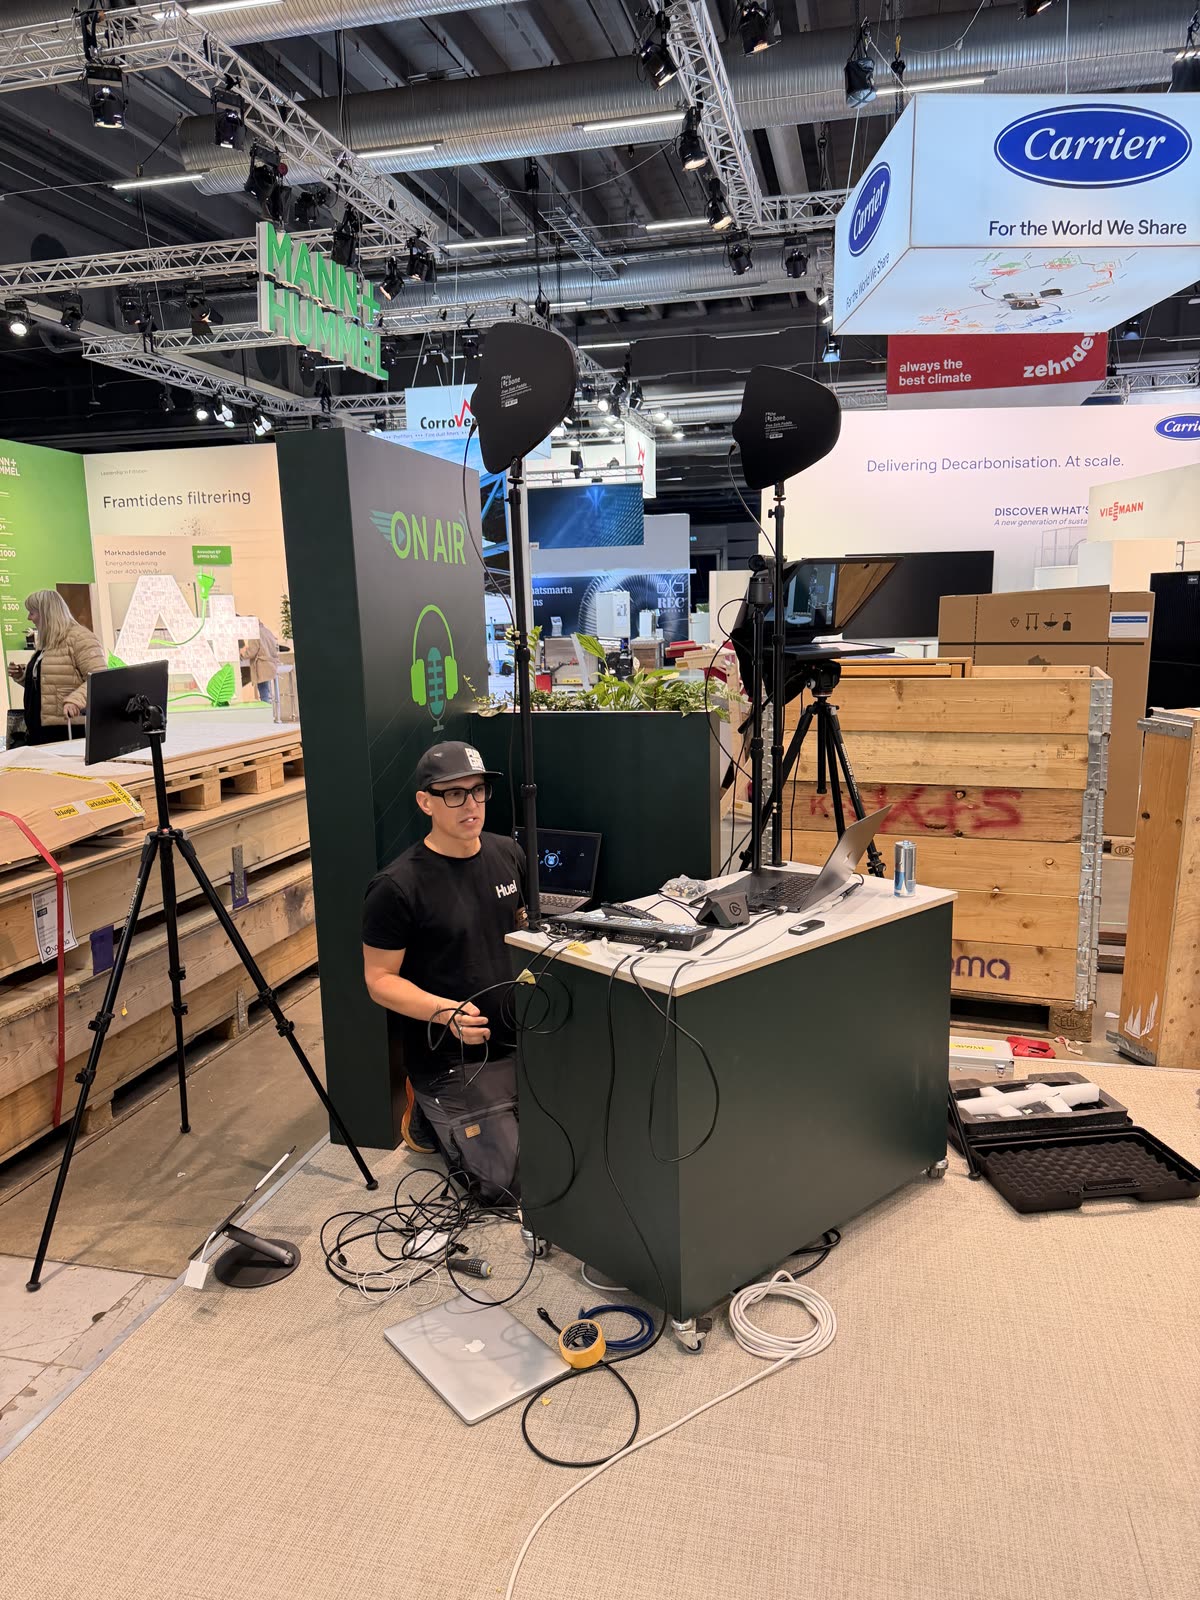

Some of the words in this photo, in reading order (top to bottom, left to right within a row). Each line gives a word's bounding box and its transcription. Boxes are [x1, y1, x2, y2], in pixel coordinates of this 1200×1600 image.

[1024, 127, 1167, 161] Carrier
[853, 181, 886, 241] Carrier
[989, 221, 1016, 236] For
[1019, 220, 1047, 236] the
[1052, 220, 1102, 236] World
[1107, 220, 1134, 235] We
[1138, 219, 1187, 235] Share
[258, 281, 389, 380] HUMMEL
[1023, 332, 1100, 378] zehnde
[899, 361, 941, 373] always
[943, 358, 963, 370] the
[898, 374, 926, 386] best
[927, 372, 972, 385] climate
[1163, 420, 1200, 433] Carri
[867, 459, 937, 474] Delivering
[941, 456, 1061, 471] Decarbonisation.
[1065, 455, 1081, 467] At
[1084, 454, 1125, 467] scale.
[103, 493, 183, 509] Framtidens
[188, 489, 251, 505] filtrering
[994, 507, 1049, 517] DISCOVER
[1100, 502, 1144, 521] VIESSMANN
[1001, 519, 1017, 527] new
[1017, 518, 1058, 528] generation
[1058, 517, 1068, 526] of
[391, 511, 429, 561] ON
[434, 519, 466, 565] AIR
[104, 549, 167, 557] Marknadsledande
[657, 597, 685, 609] REC
[495, 879, 518, 899] Huel
[951, 955, 1010, 981] ma
